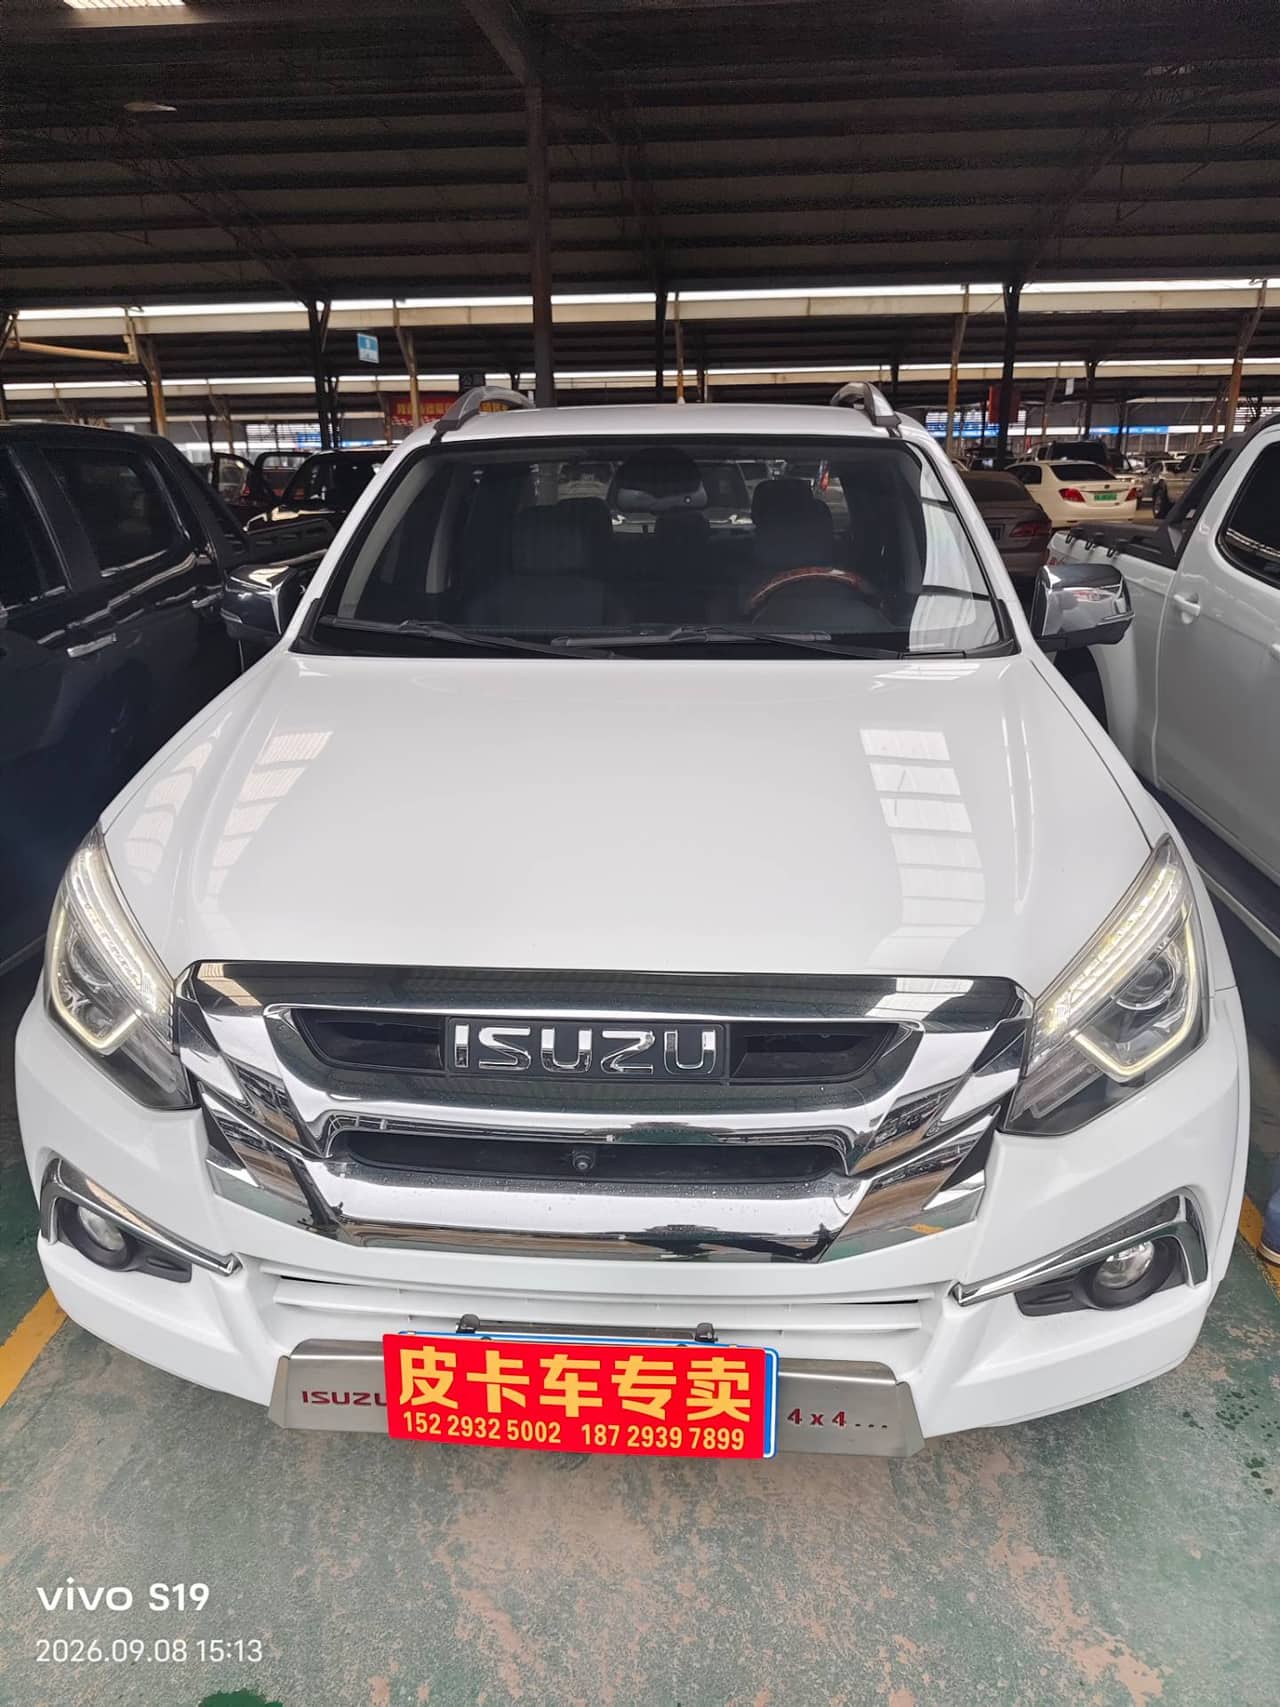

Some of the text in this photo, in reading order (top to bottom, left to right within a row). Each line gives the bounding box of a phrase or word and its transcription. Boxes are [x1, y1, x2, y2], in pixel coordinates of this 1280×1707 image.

[454, 1023, 717, 1075] ISUZU
[399, 1345, 751, 1423] 皮卡车专卖
[403, 1410, 745, 1450] 152 2932 5002 187 2939 7899
